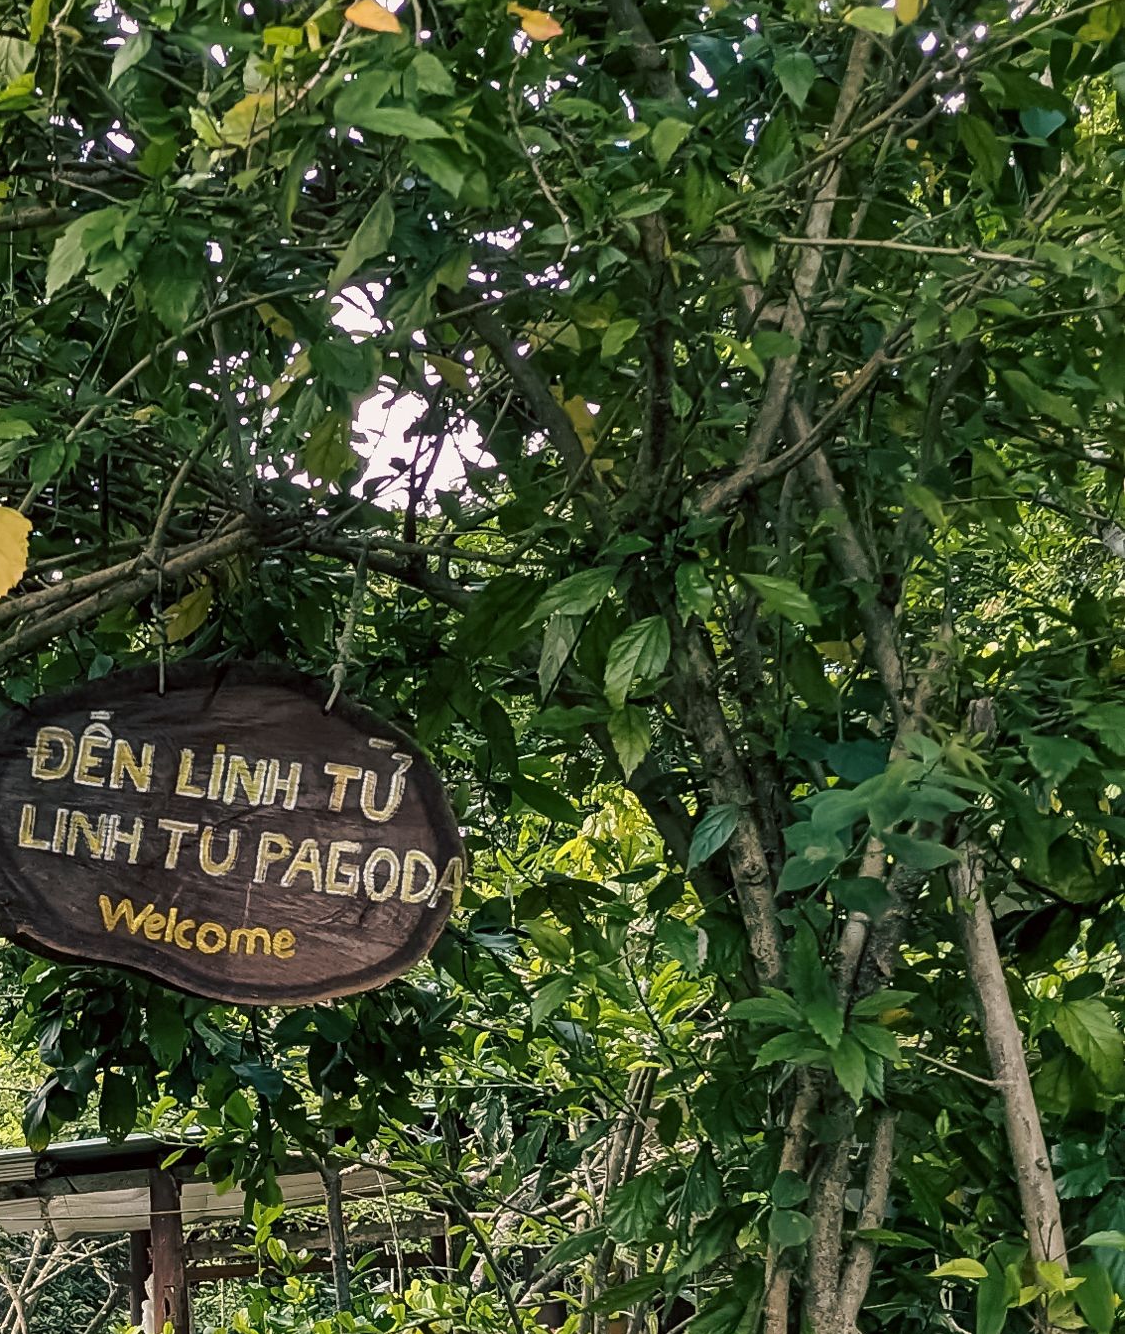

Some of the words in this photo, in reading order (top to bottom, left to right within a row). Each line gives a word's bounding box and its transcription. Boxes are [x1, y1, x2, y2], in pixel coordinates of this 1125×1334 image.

[18, 803, 144, 865] LINH
[158, 819, 239, 877] TU
[253, 832, 464, 908] PAGODA
[98, 894, 297, 959] Welcome
